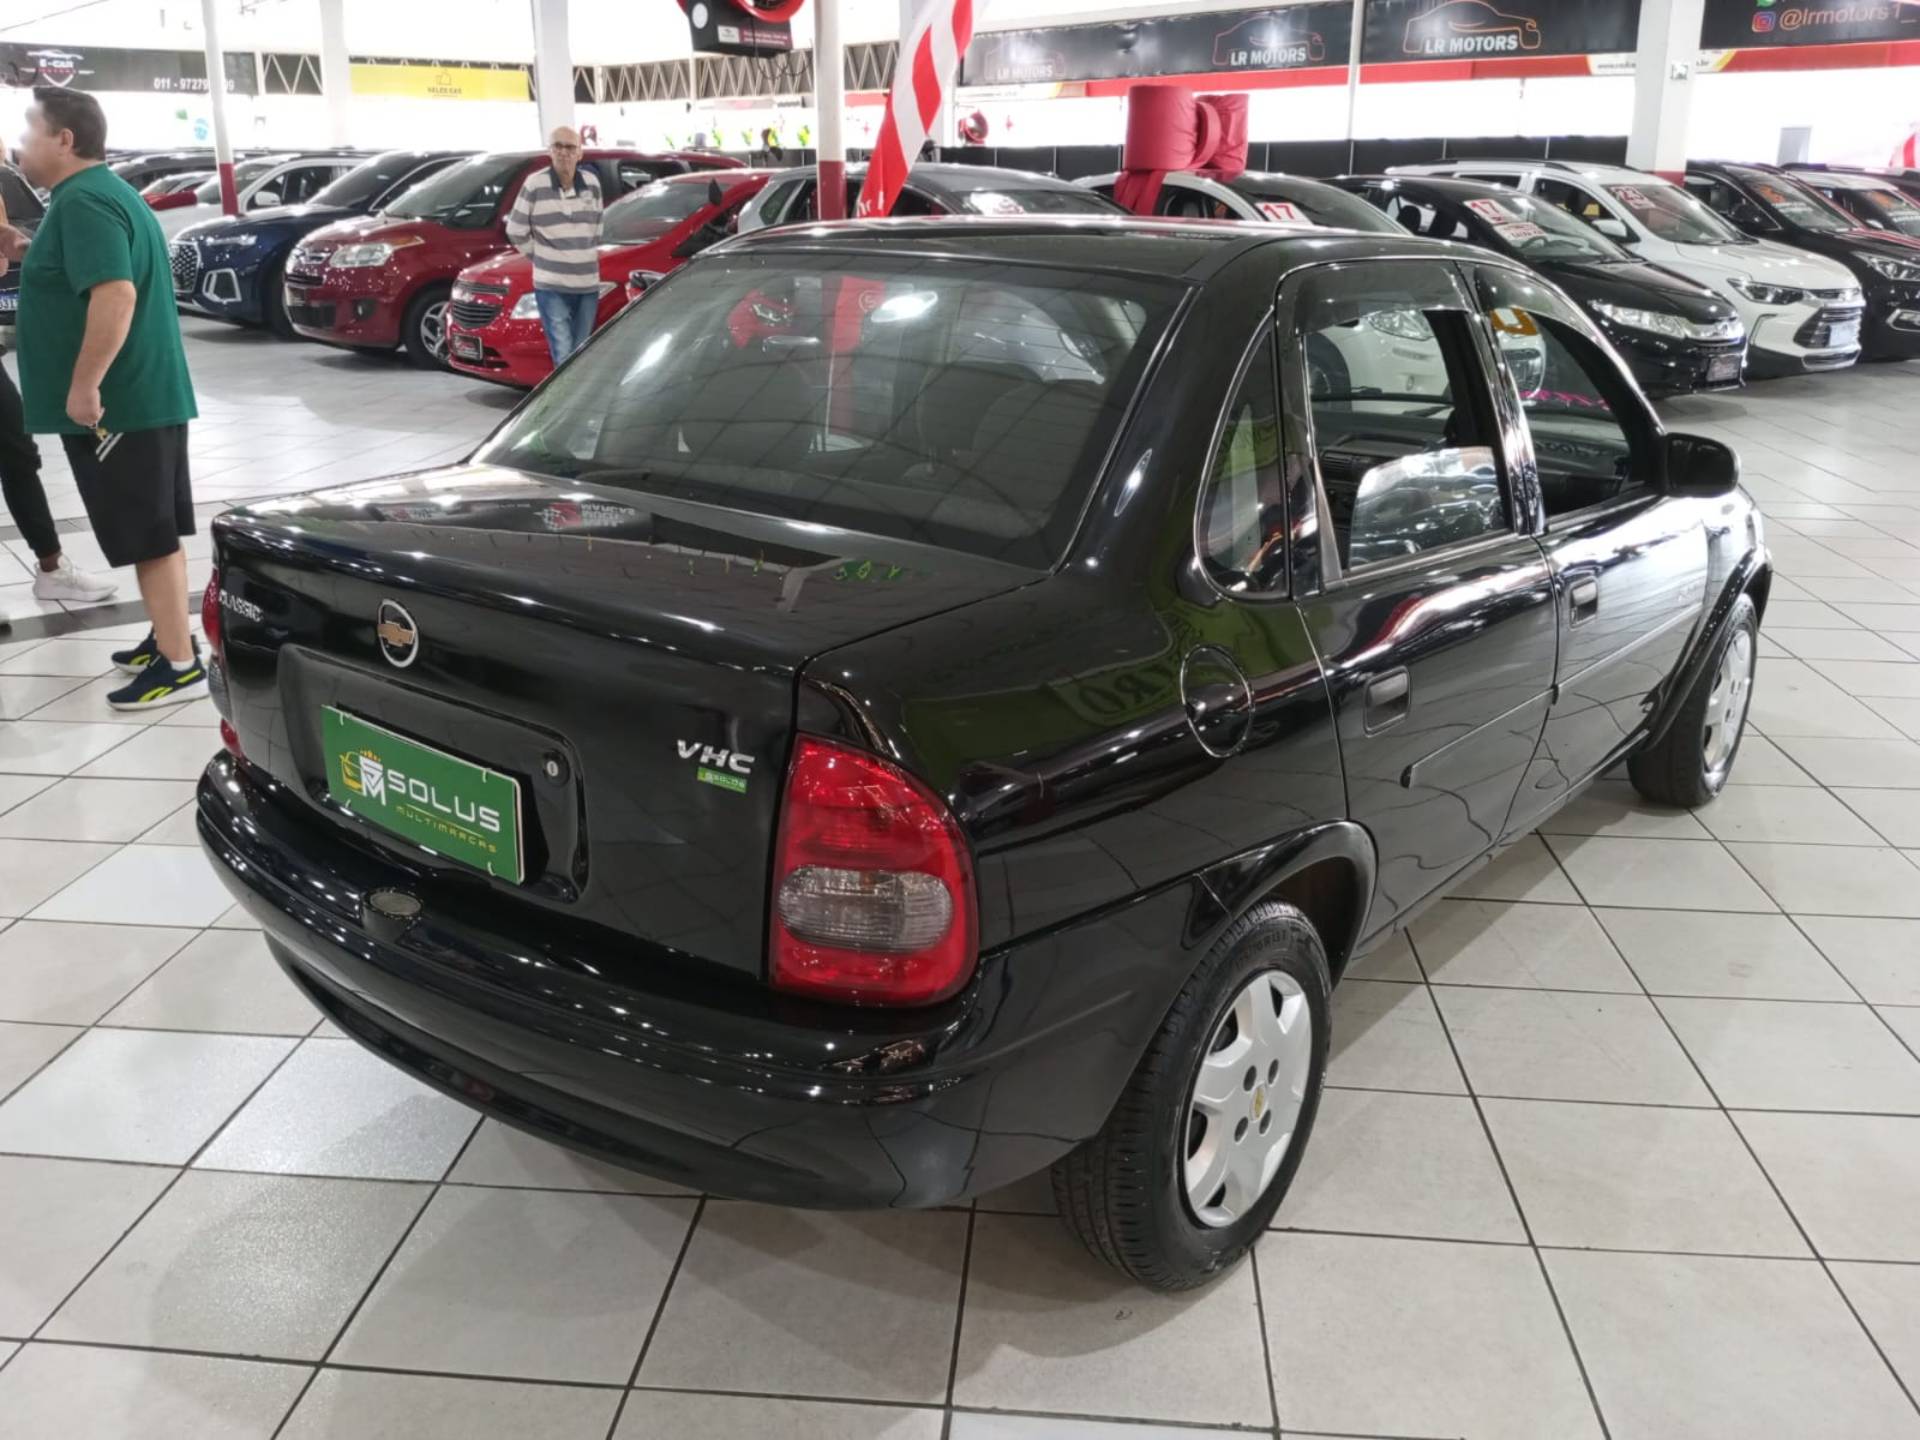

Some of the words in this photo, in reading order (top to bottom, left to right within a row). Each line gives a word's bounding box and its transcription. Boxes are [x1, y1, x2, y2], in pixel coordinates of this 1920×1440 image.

[1424, 39, 1445, 54] LR
[1449, 35, 1518, 53] MOTORS
[1230, 51, 1248, 66] LR
[1250, 47, 1307, 65] MOTORS
[153, 77, 171, 89] 011
[1263, 203, 1295, 220] 17
[678, 739, 755, 774] VHC
[387, 769, 500, 833] SOLUS
[395, 805, 497, 853] MULTIMARCAS
